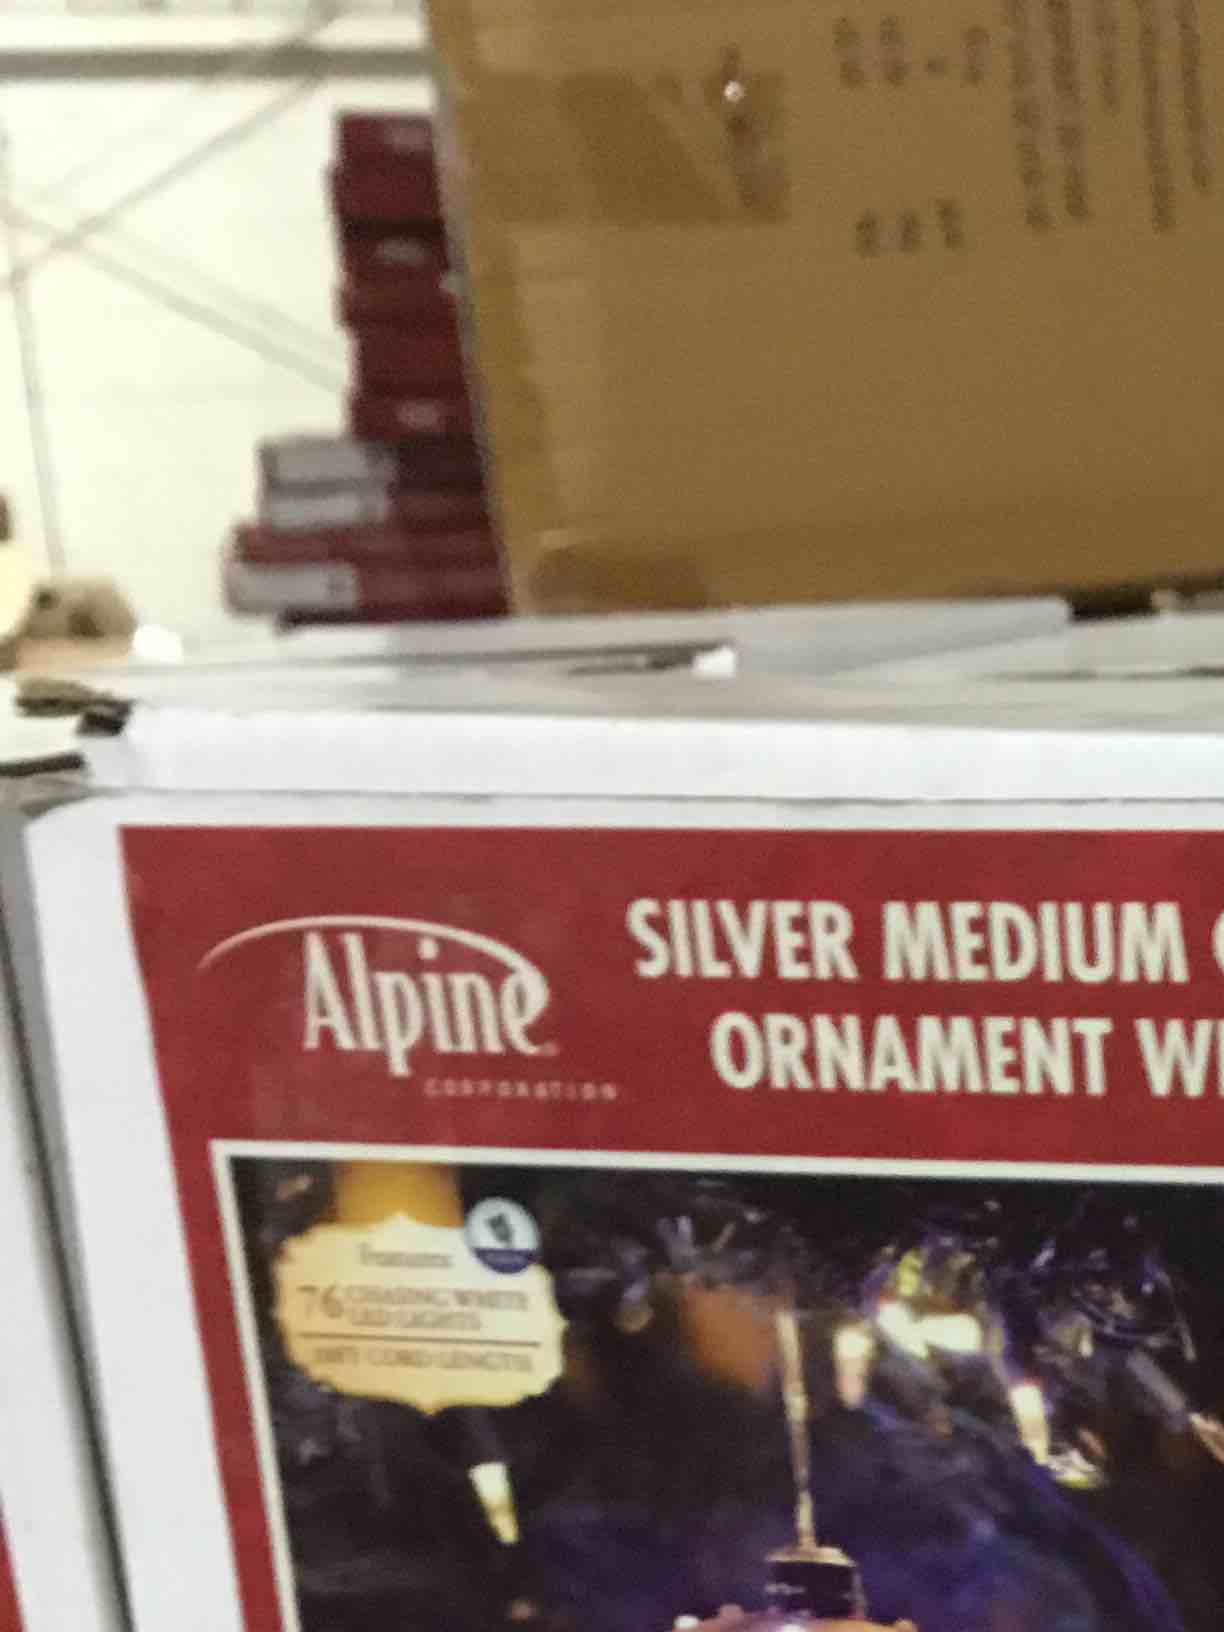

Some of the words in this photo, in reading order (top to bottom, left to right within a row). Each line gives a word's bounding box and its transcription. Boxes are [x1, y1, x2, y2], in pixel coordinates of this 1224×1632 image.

[626, 898, 858, 979] SILVER
[883, 898, 1188, 981] MEDIUM
[303, 931, 549, 1077] Alpine
[710, 1009, 1113, 1095] ORNAMENT
